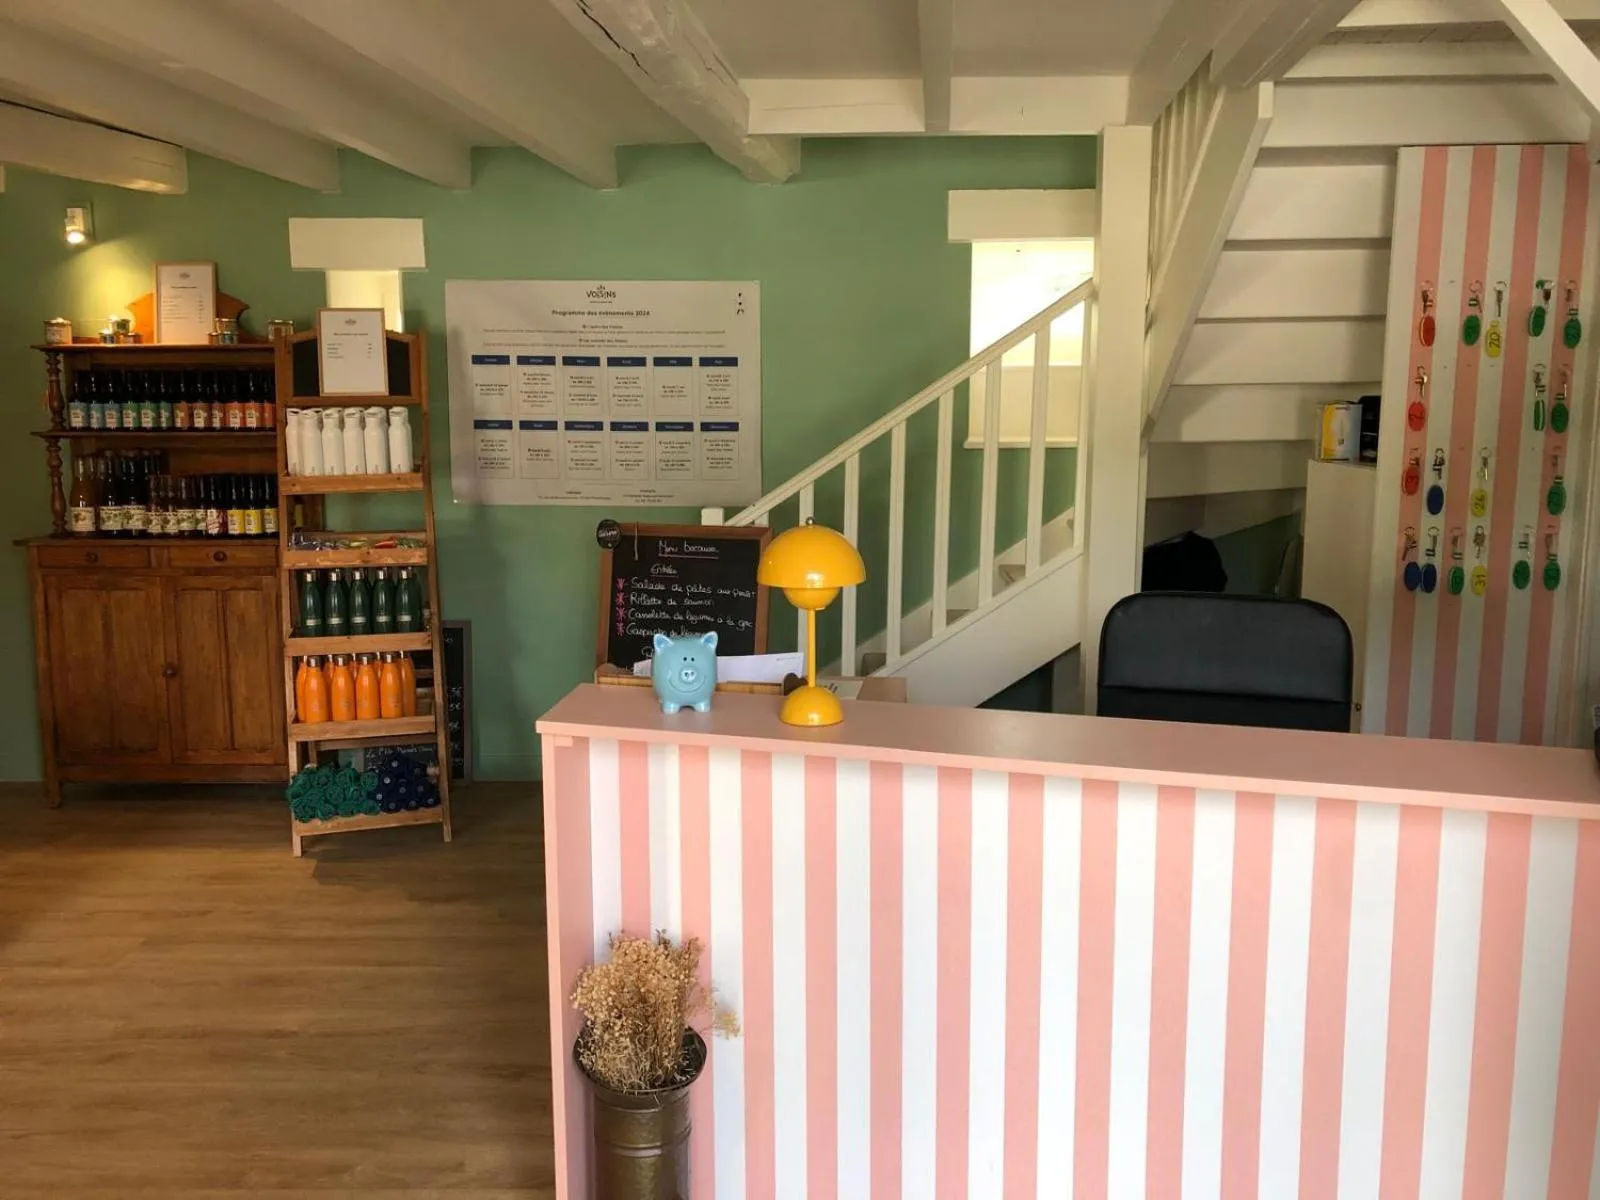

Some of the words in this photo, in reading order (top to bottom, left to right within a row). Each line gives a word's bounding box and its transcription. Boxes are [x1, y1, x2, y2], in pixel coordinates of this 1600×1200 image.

[631, 577, 666, 589] Salade
[671, 583, 683, 592] de
[667, 596, 677, 605] de
